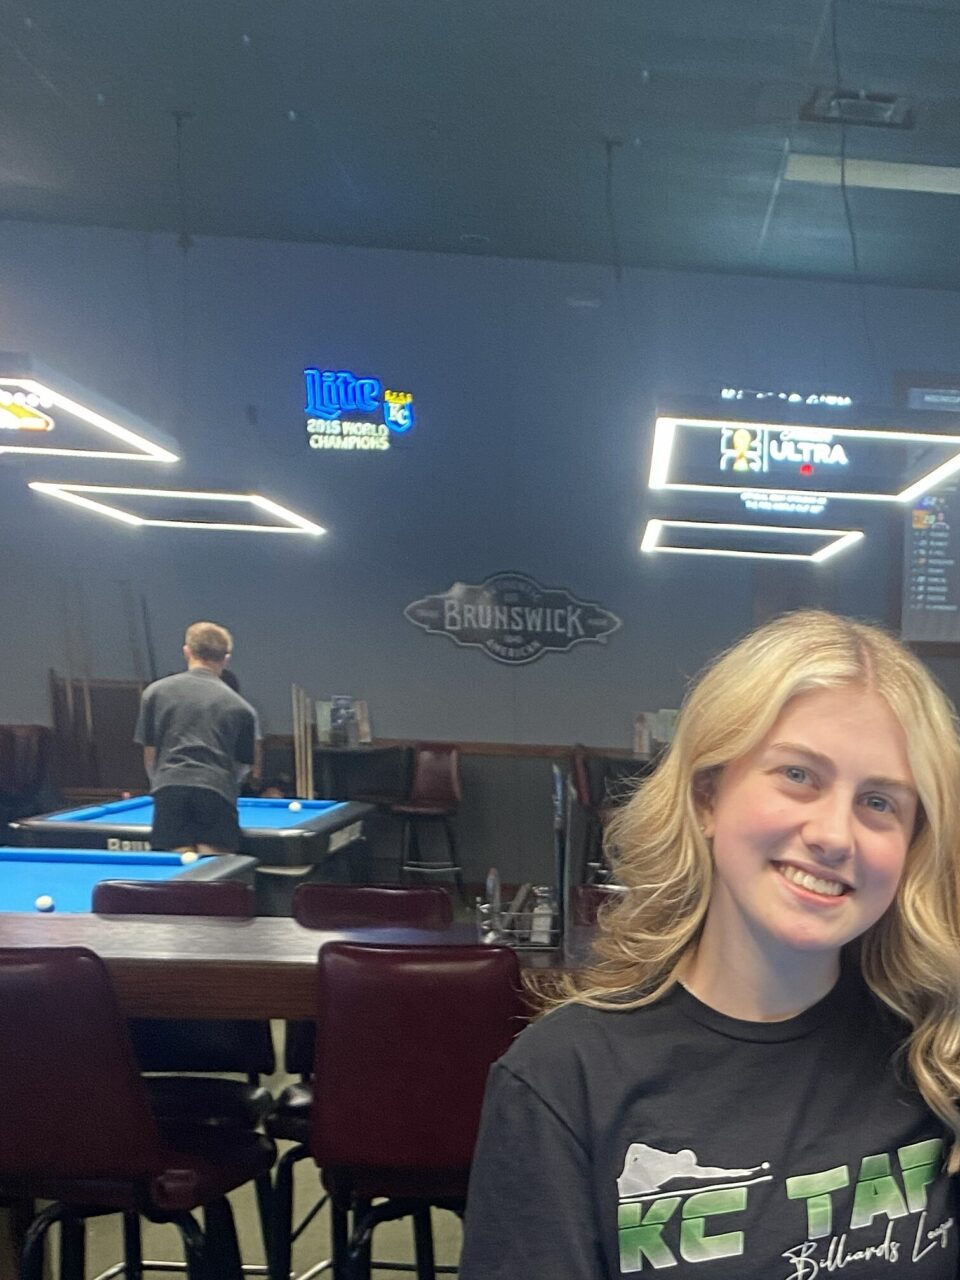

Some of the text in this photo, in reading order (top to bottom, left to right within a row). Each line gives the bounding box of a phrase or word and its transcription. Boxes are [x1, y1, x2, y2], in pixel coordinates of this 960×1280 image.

[304, 369, 380, 419] Lite
[307, 419, 389, 437] 2015 WORLD
[309, 434, 390, 450] CHAMPIONS
[769, 438, 849, 466] ULTRA
[444, 600, 585, 638] BRUNSWICK
[617, 1187, 748, 1273] KC
